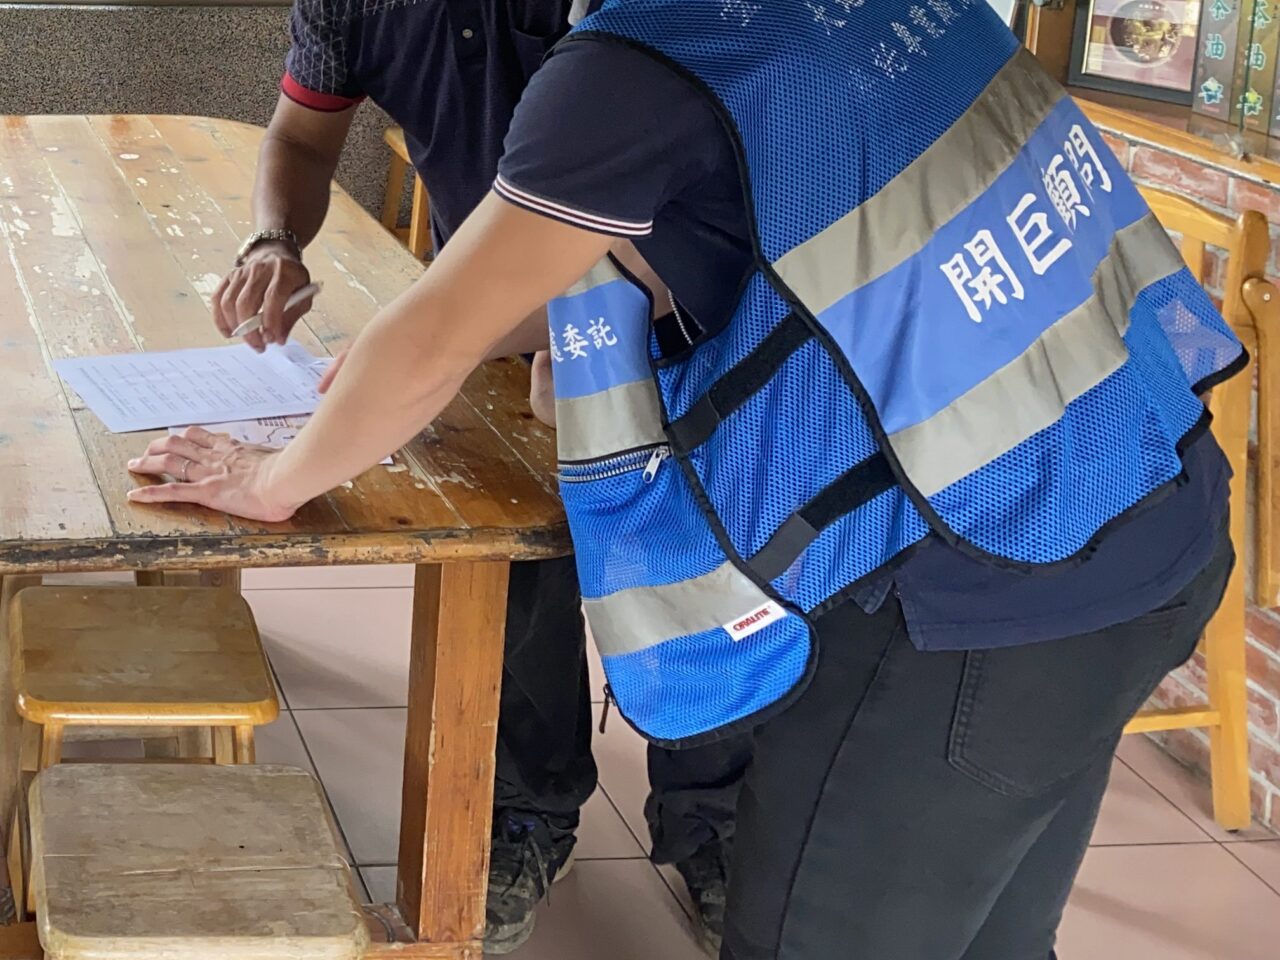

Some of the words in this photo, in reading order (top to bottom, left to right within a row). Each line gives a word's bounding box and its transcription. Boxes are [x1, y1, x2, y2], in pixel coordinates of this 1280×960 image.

[939, 123, 1113, 323] 開巨顧問
[733, 607, 771, 632] ORALITE
